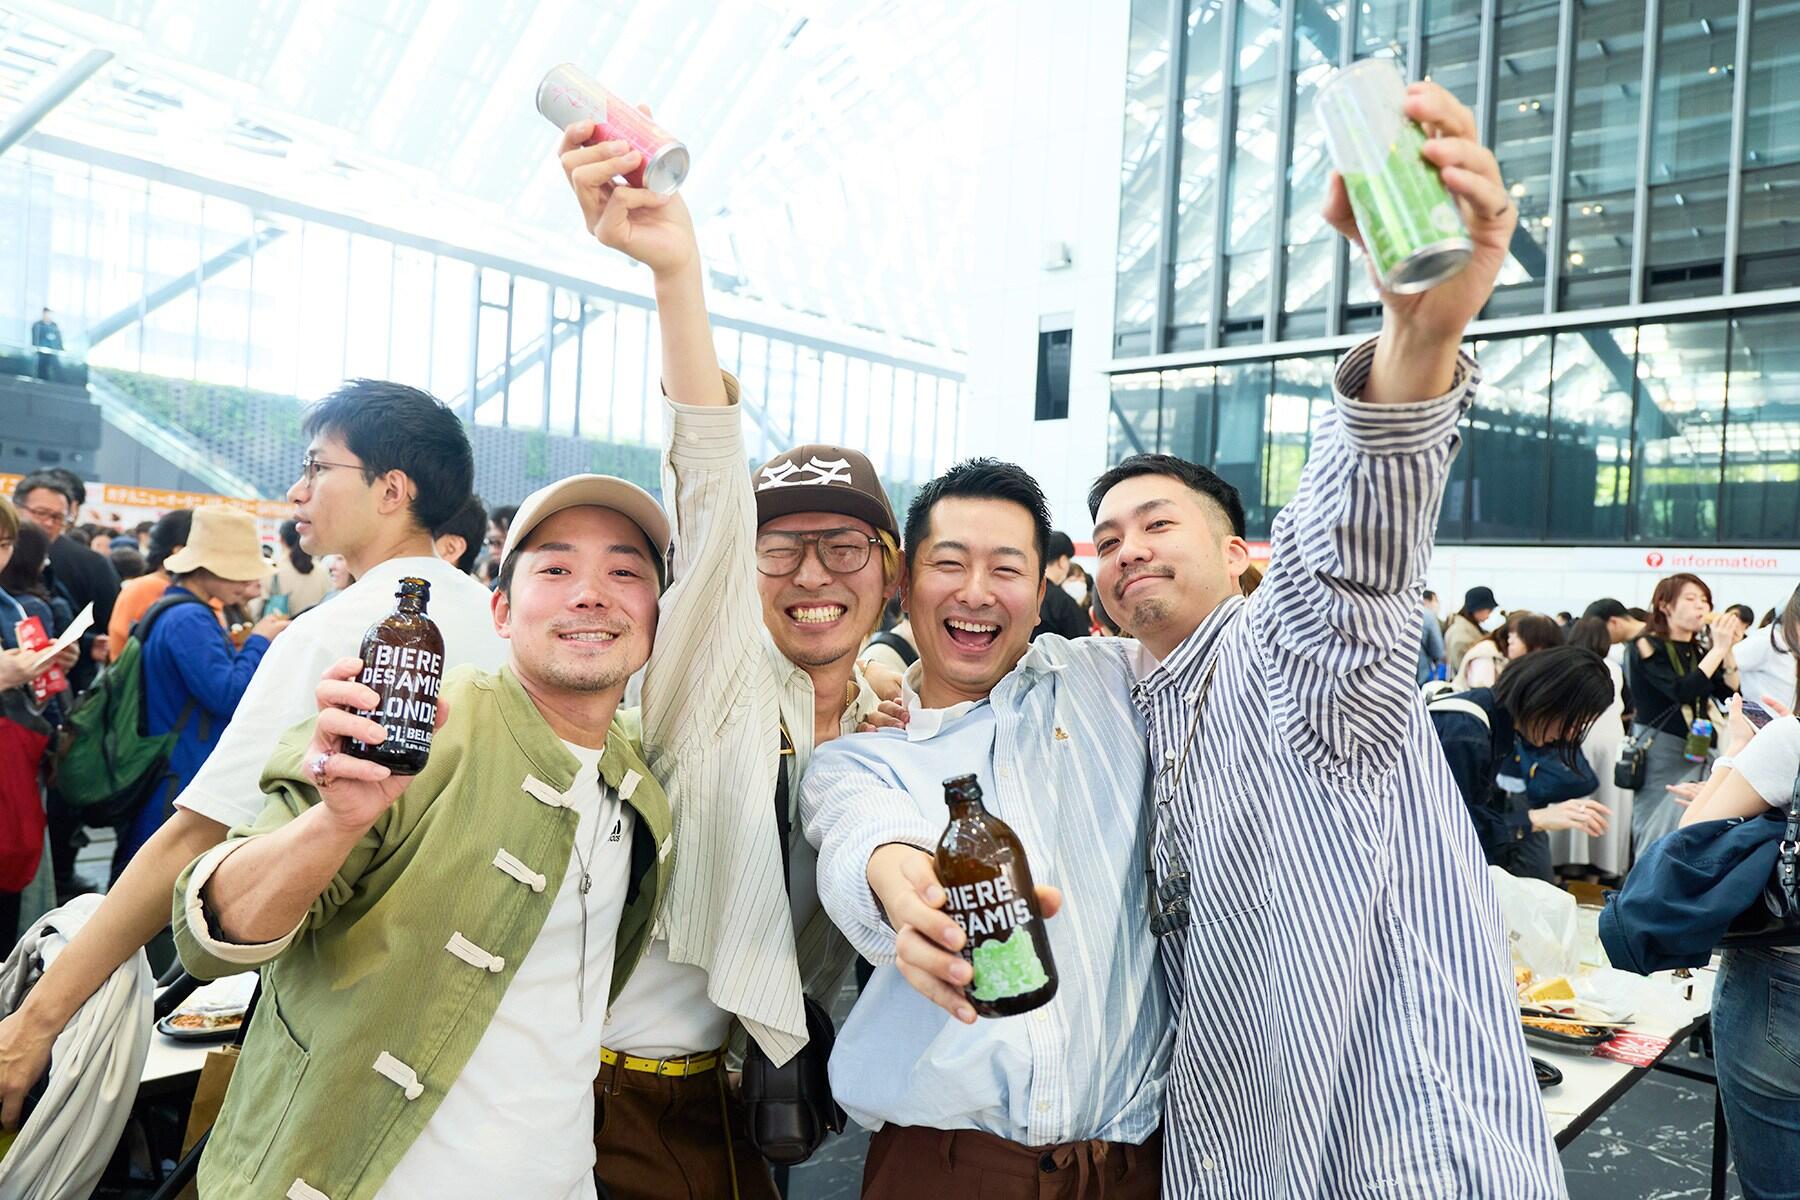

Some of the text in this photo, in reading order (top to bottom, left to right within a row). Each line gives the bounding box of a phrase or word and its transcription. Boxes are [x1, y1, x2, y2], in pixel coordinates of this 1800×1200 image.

[1671, 554, 1778, 569] information
[376, 645, 441, 674] BIERE
[362, 667, 441, 697] DES AMIS
[357, 696, 437, 725] ONDE
